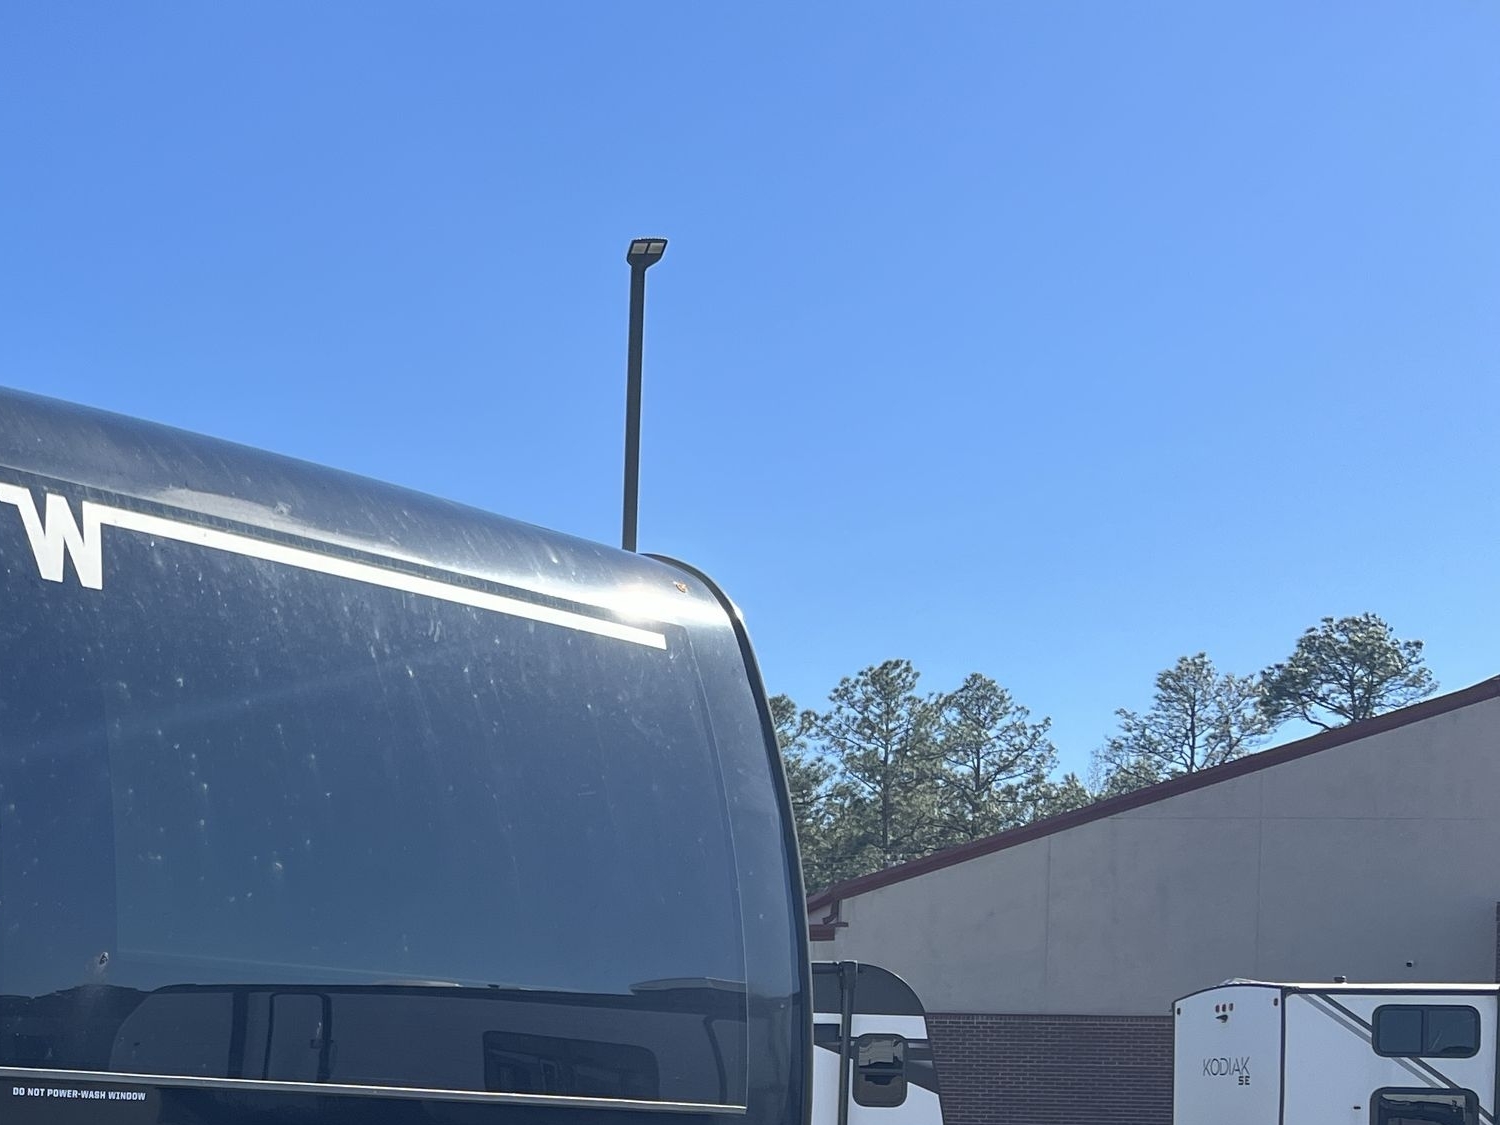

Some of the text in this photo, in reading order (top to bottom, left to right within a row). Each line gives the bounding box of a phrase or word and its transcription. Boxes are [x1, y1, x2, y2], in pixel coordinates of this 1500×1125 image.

[1202, 1056, 1250, 1076] KODIAK
[1238, 1075, 1250, 1086] SE
[12, 1086, 146, 1101] DO NOT POWER-WASH WINDOW
